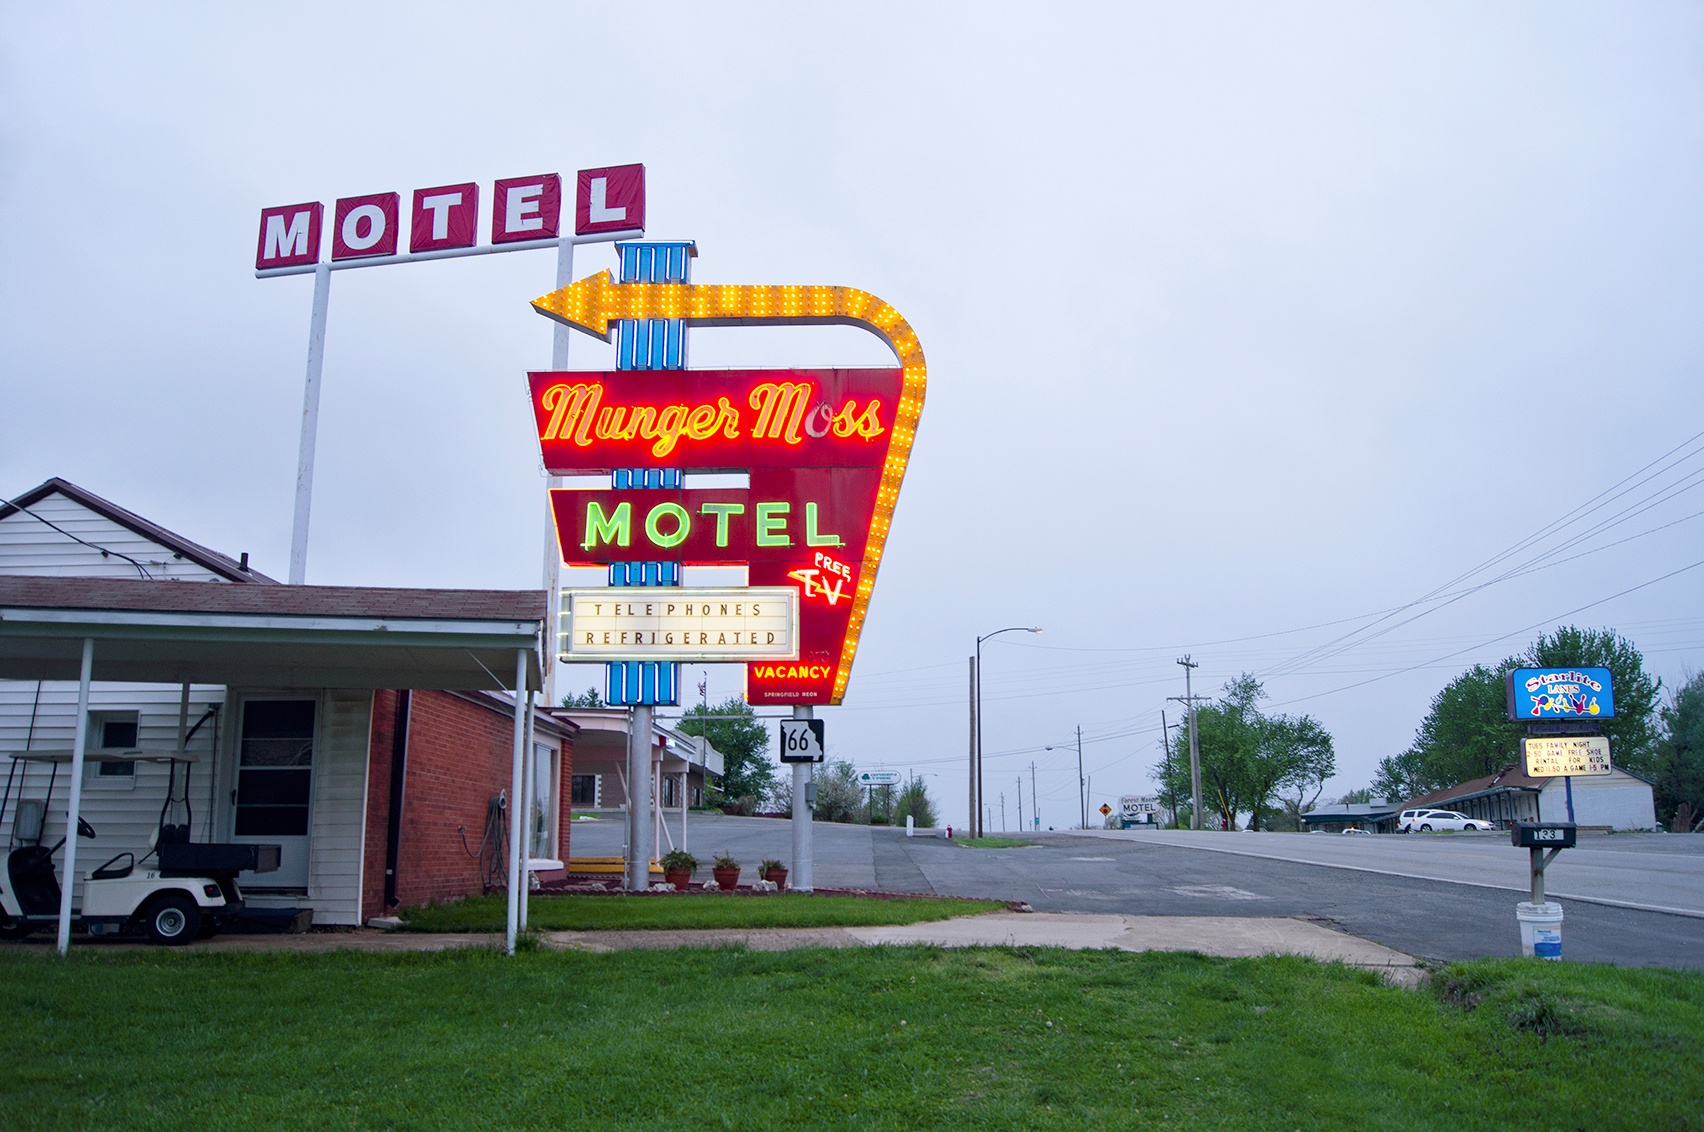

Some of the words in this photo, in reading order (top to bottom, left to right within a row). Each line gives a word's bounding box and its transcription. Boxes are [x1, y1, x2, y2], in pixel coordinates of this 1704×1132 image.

[263, 176, 626, 260] MOTEL
[540, 381, 740, 457] Munger
[749, 382, 885, 444] Moss
[582, 502, 843, 549] MOTEL
[794, 569, 844, 605] TV
[594, 603, 761, 616] TELEPHONES
[585, 632, 775, 645] REFRIGERATED
[754, 665, 831, 679] VACANCY
[1525, 671, 1602, 692] Starlite
[1547, 684, 1580, 694] LANES
[788, 728, 809, 751] 66
[1123, 803, 1156, 812] MOTEL
